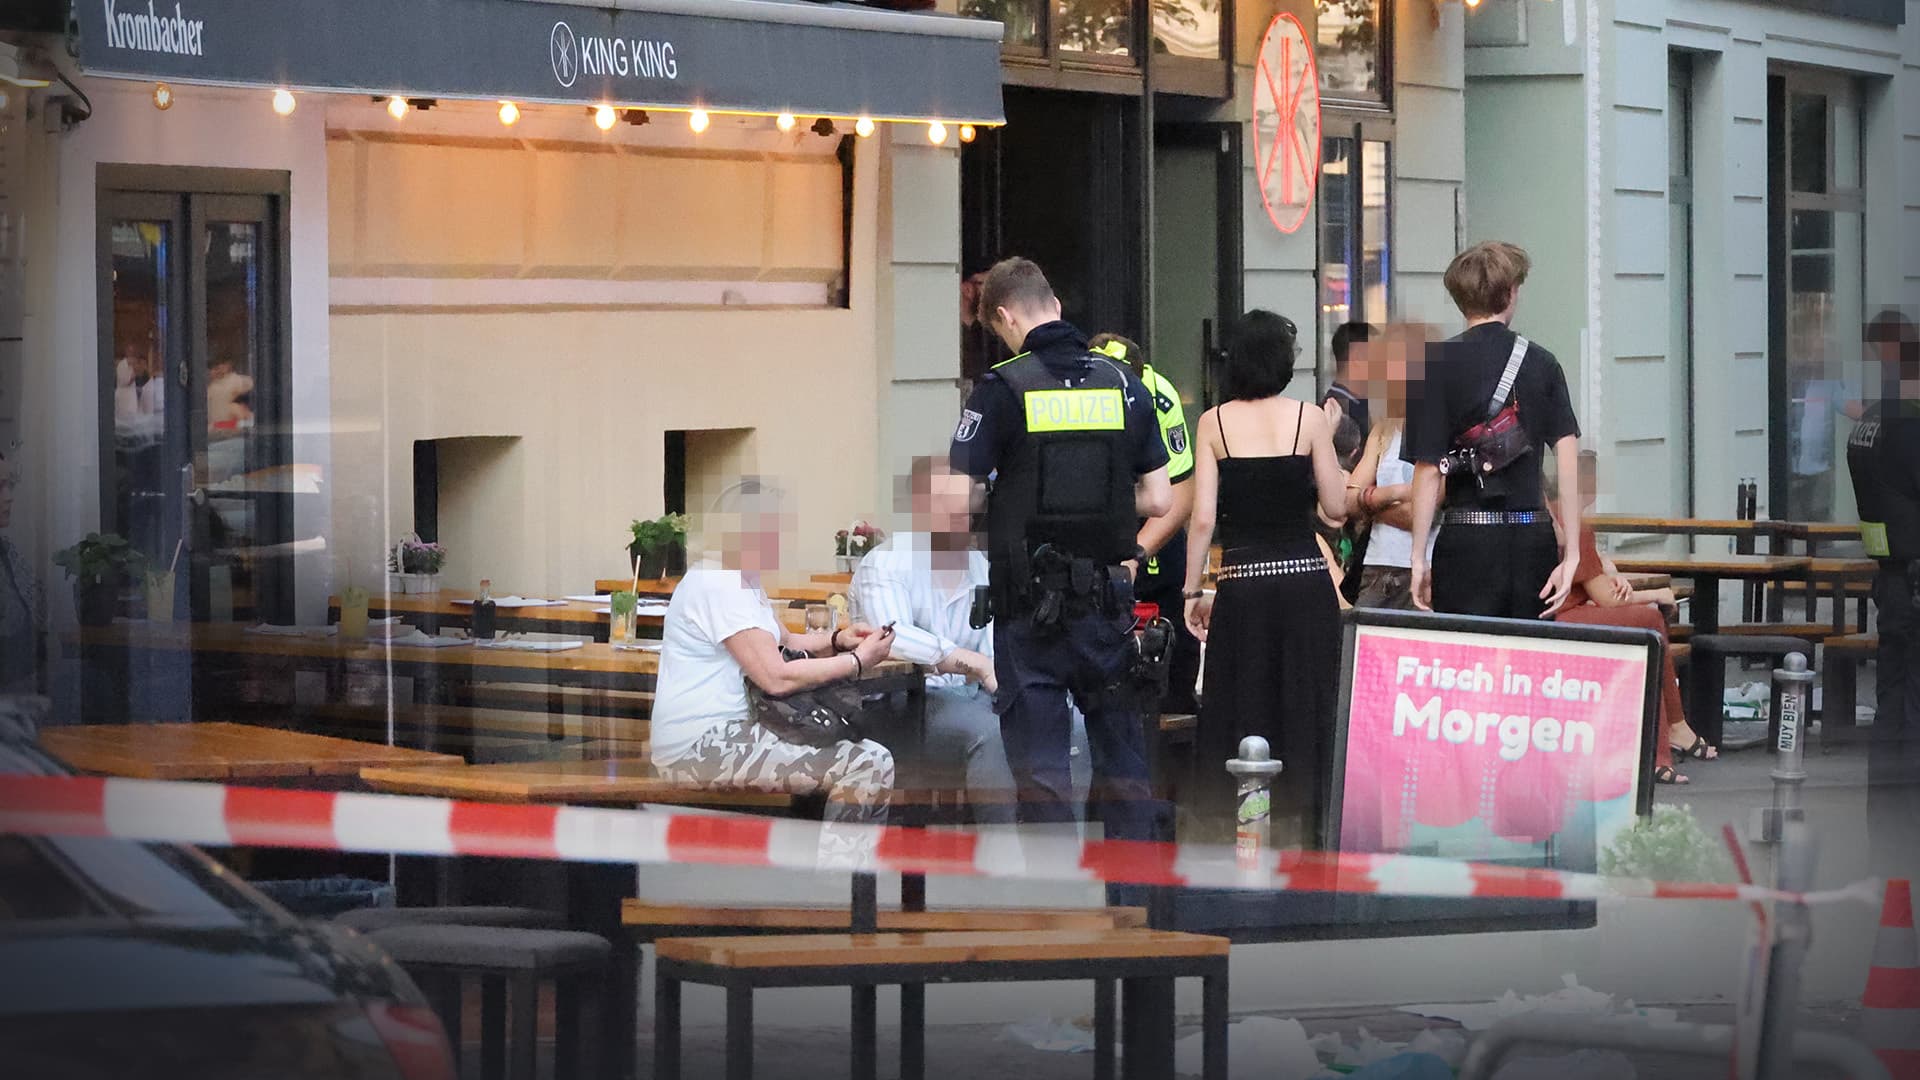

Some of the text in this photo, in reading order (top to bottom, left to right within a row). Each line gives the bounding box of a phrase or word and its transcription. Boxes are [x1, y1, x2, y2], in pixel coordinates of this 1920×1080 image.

[104, 0, 203, 56] Krombacher
[581, 37, 677, 79] KING KING
[1031, 396, 1120, 424] POLIZEI
[1396, 656, 1602, 702] Frisch in den
[1393, 692, 1595, 761] Morgen
[1780, 694, 1798, 750] MUY BIEN
